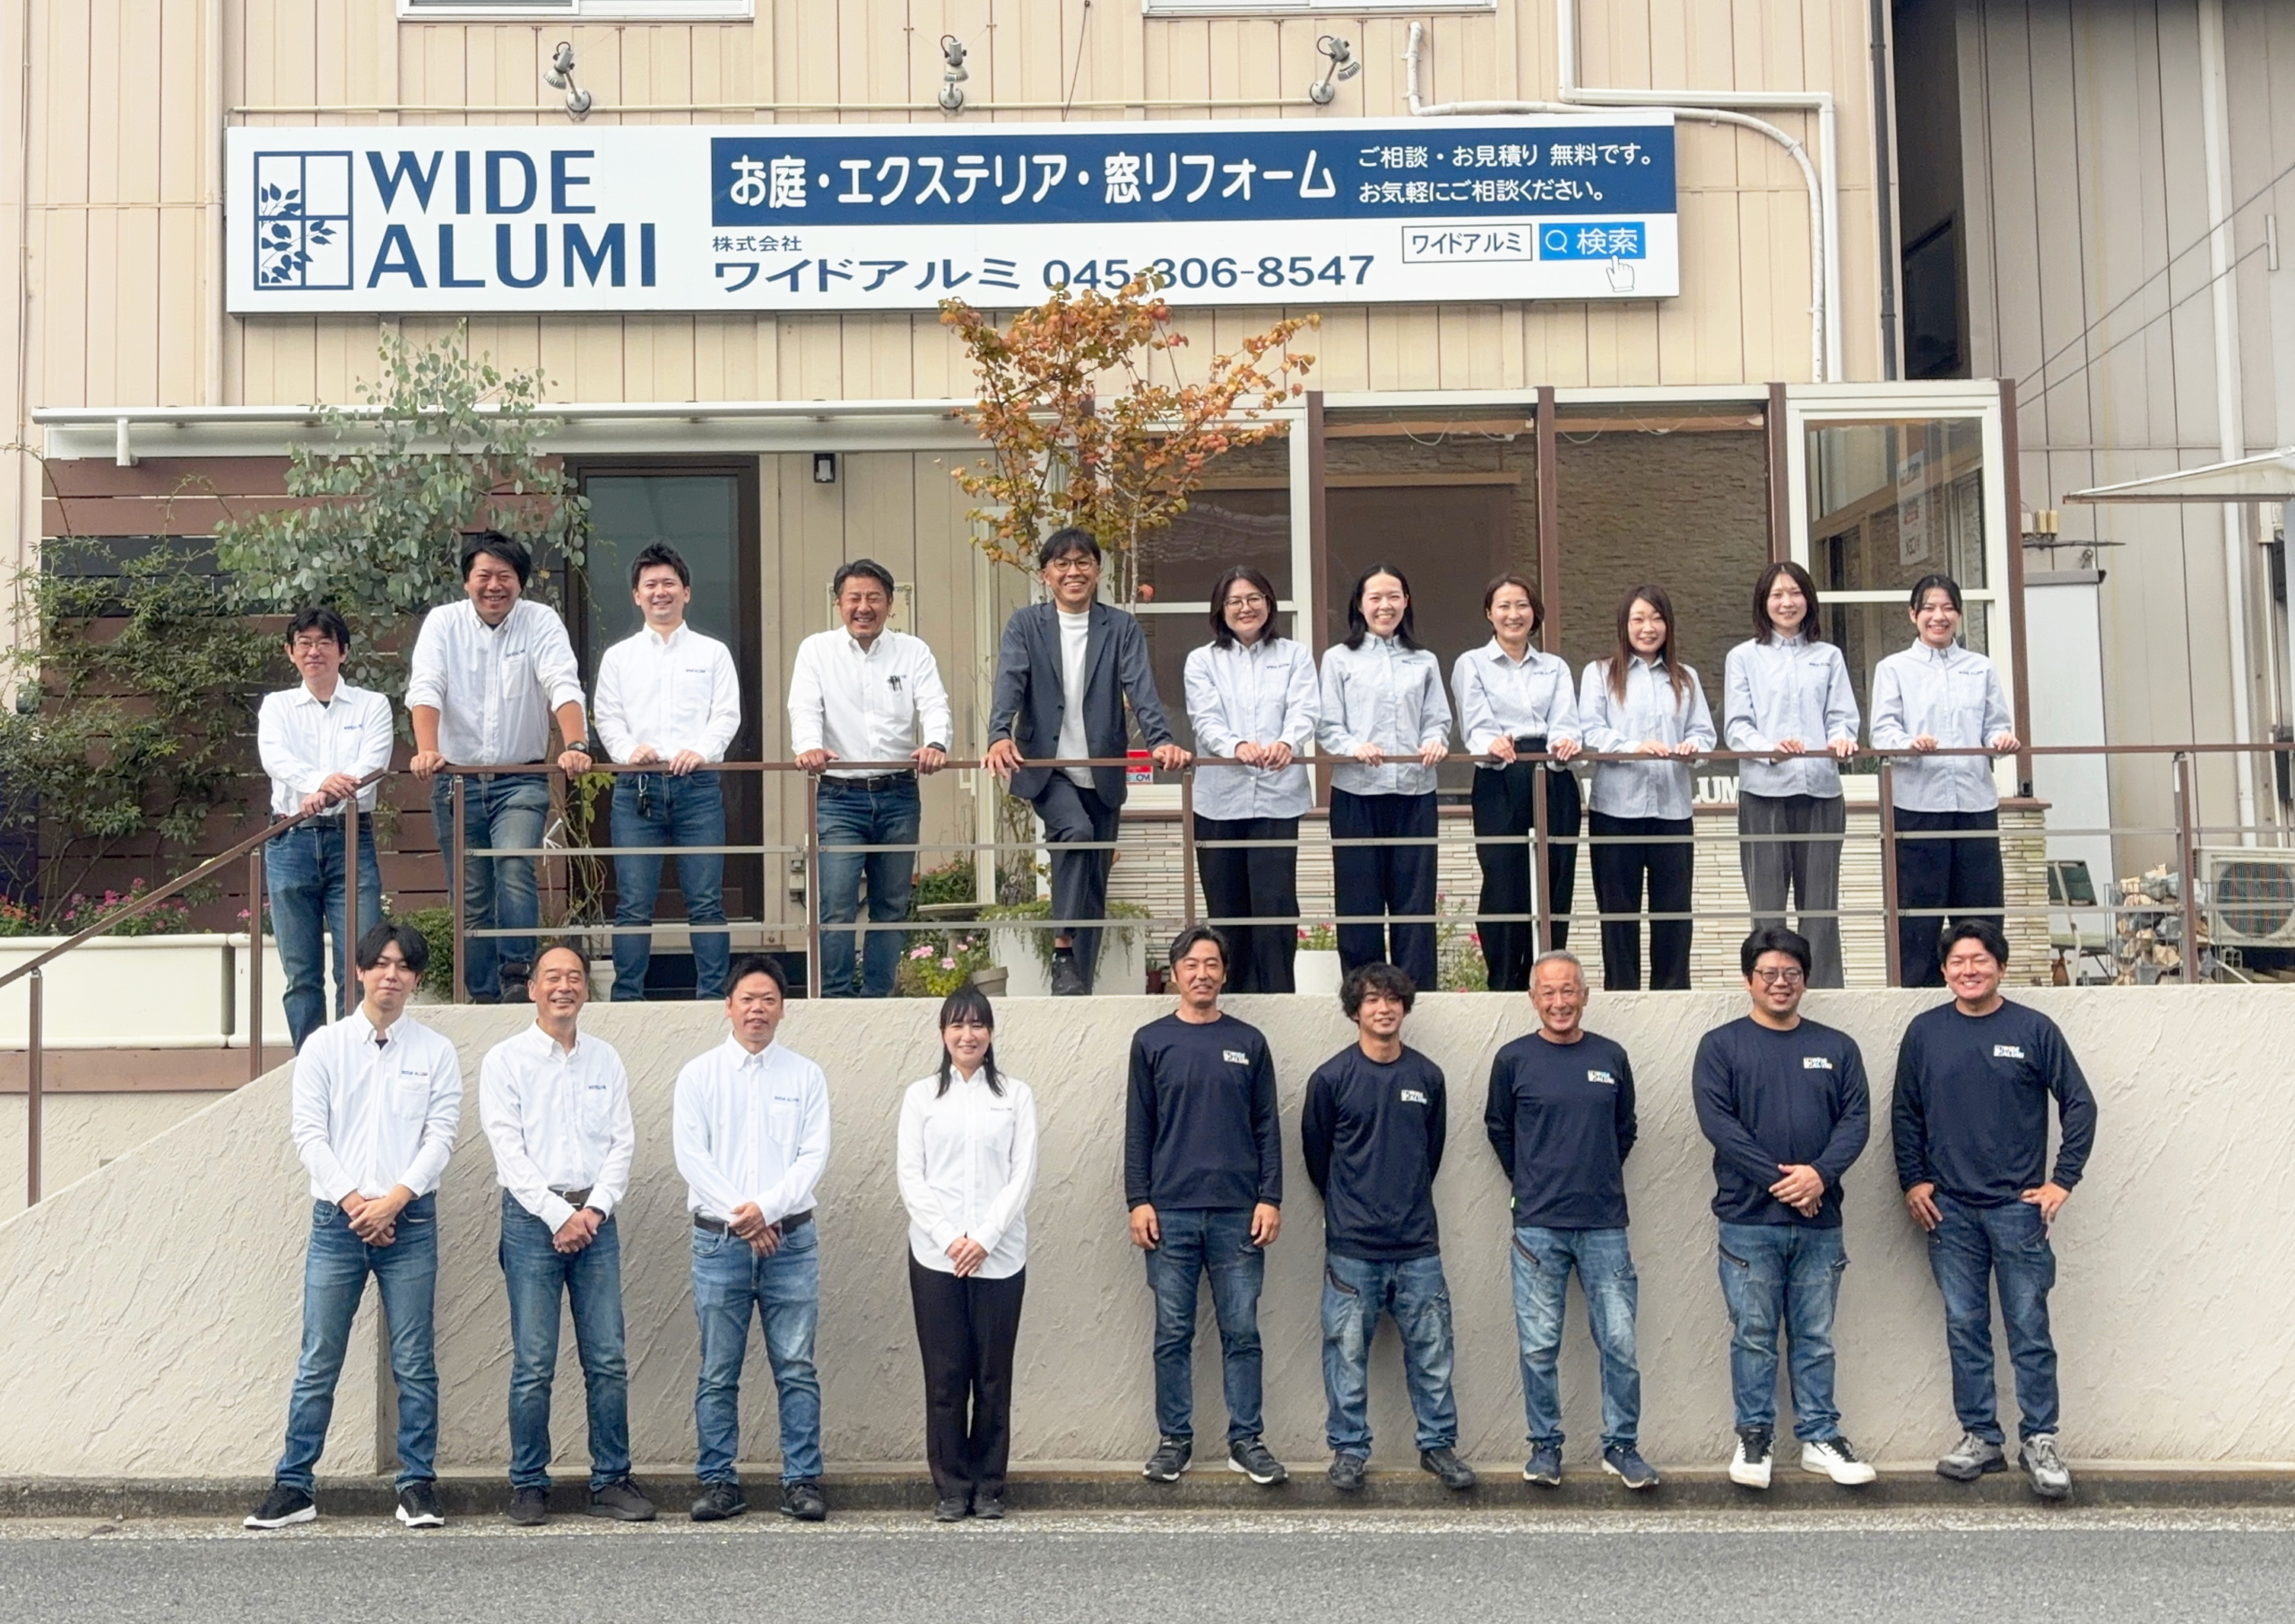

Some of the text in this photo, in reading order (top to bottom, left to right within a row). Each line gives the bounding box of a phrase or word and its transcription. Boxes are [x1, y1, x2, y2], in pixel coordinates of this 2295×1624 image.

[1359, 143, 1650, 168] ご相談・お見積り 無料です。
[367, 150, 596, 215] WIDE
[731, 150, 1336, 208] お庭・エクステリア・窓リフォーム
[1359, 179, 1603, 203] お気軽にご相談ください。
[713, 236, 802, 252] 株式会社
[1413, 231, 1521, 254] ワイドアルミ
[1576, 227, 1638, 255] 検索
[368, 222, 656, 289] ALUMI
[714, 255, 1374, 290] ワイドアルミ 045-306-8547
